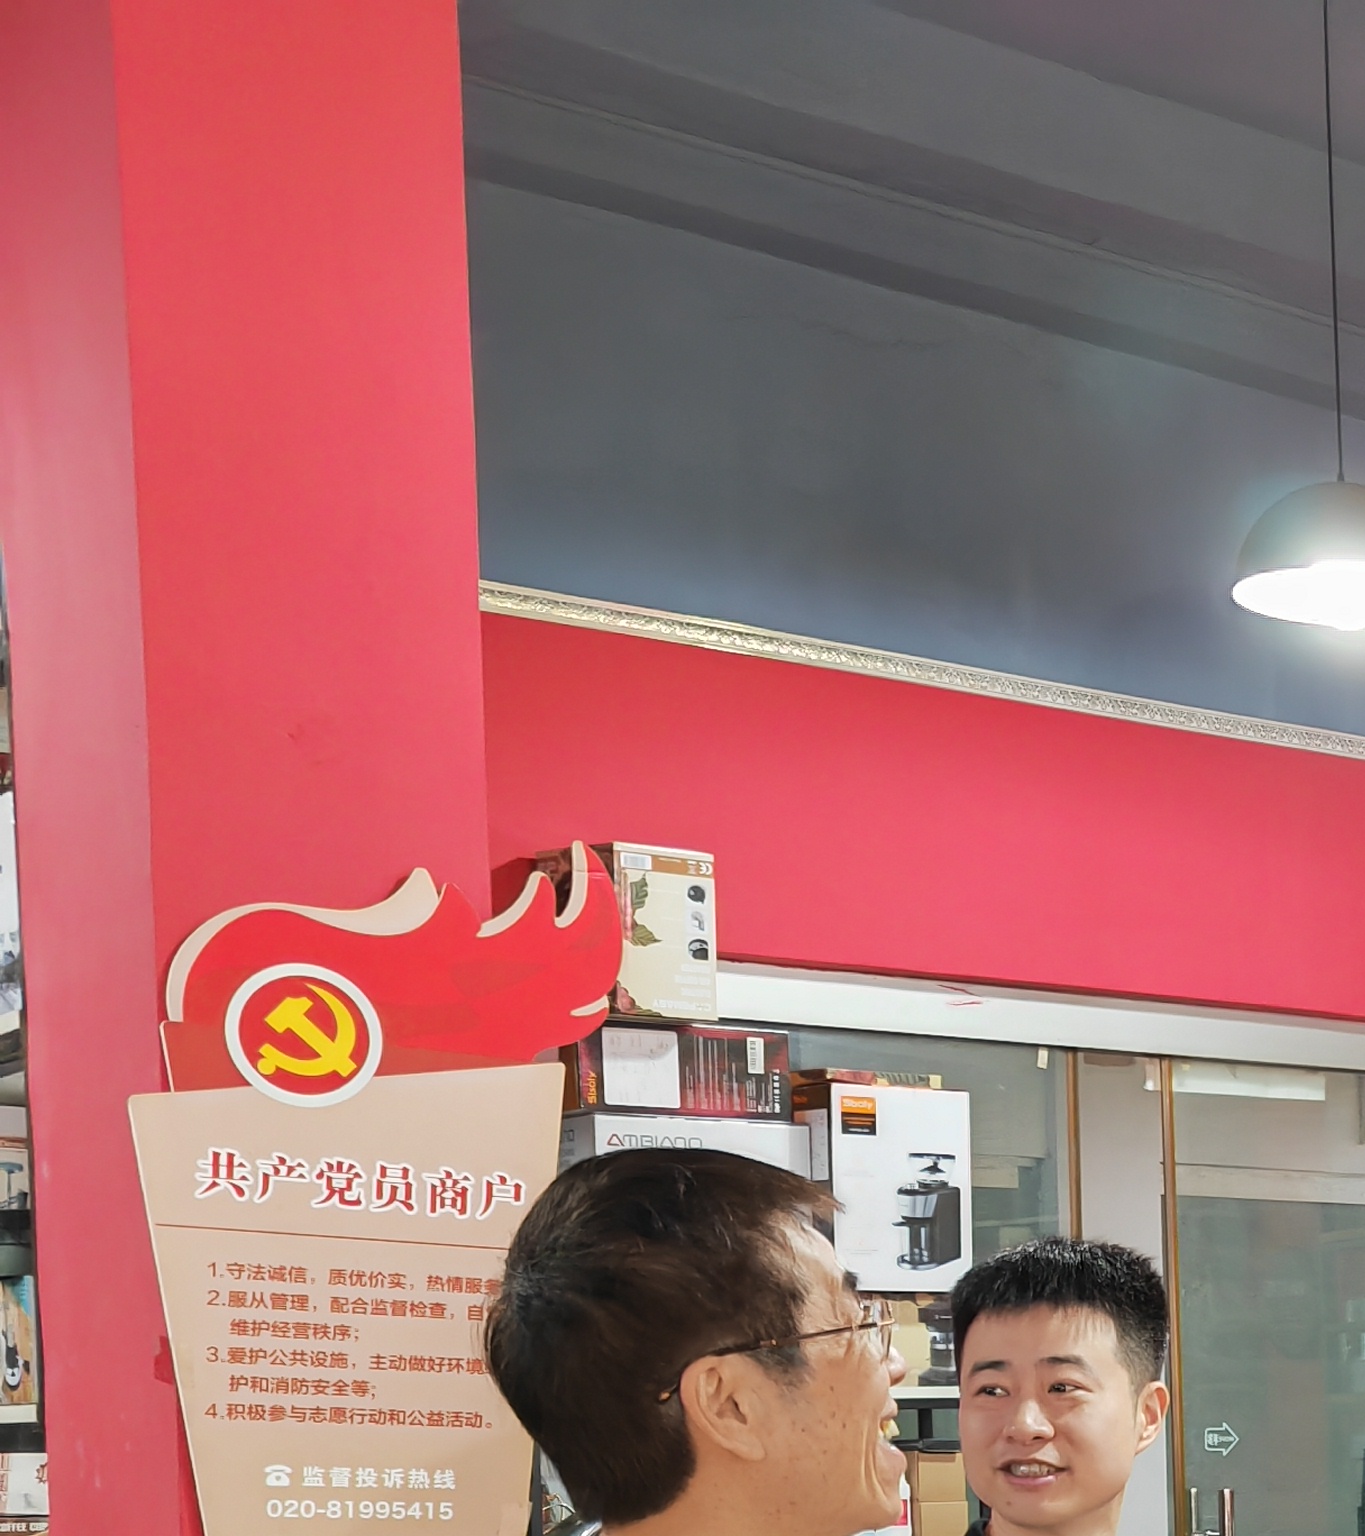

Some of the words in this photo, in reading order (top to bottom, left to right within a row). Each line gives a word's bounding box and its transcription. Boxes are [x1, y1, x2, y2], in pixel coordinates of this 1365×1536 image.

[195, 1147, 525, 1220] 共产党员商户
[206, 1290, 489, 1322] 2.服从管理，配合监督检查，自
[206, 1347, 492, 1375] 3.爱护公共设施，主动做好环境
[302, 1466, 456, 1490] 监督投诉热线
[266, 1499, 454, 1520] 020-81995415
